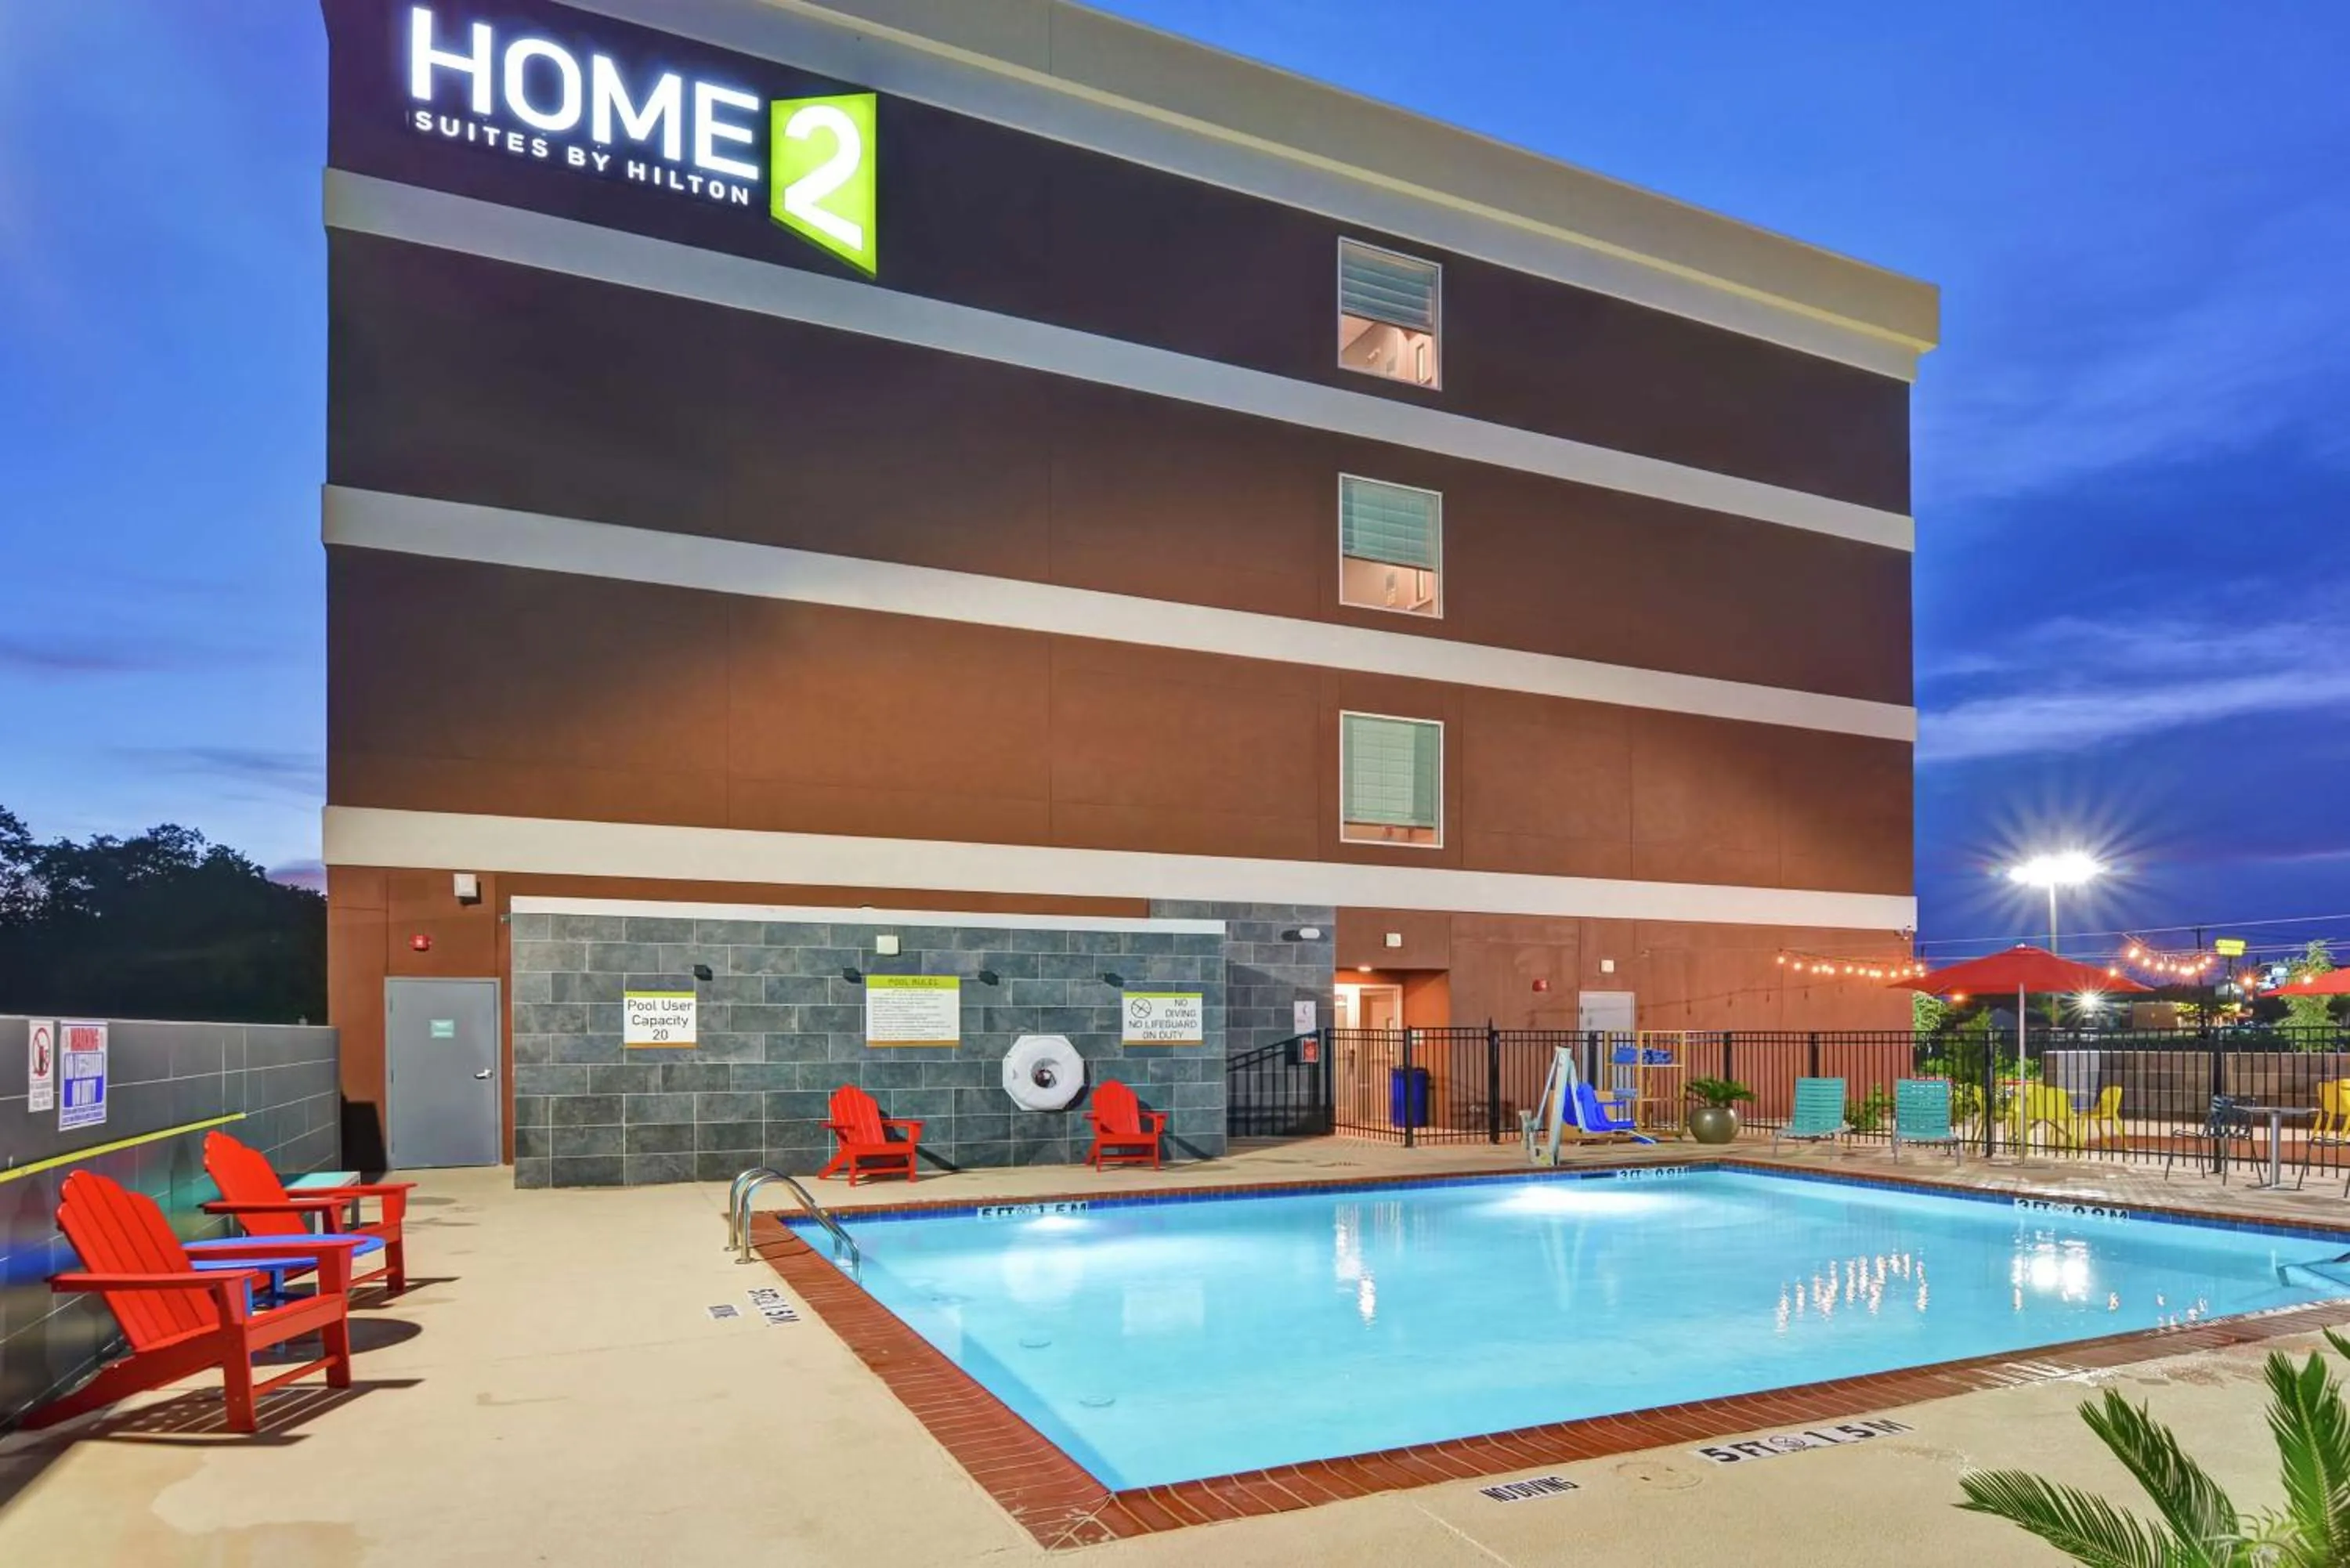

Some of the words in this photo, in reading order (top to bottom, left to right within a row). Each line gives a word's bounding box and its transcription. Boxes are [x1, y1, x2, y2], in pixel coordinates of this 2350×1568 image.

[411, 6, 759, 180] HOME
[783, 105, 863, 251] 2
[414, 110, 548, 158] SUITES
[567, 146, 611, 172] BY
[627, 161, 750, 206] HILTON
[627, 999, 657, 1011] Pool
[661, 999, 693, 1011] User
[1173, 999, 1188, 1007] NO
[1165, 1009, 1196, 1017] DIVING
[632, 1014, 689, 1028] Capacity
[1128, 1020, 1143, 1028] NO
[1144, 1020, 1197, 1028] LIFEGUARD
[652, 1028, 668, 1041] 20
[1142, 1031, 1157, 1039] ON
[1159, 1031, 1184, 1039] DUTY
[1479, 1487, 1519, 1502] NO
[1504, 1476, 1579, 1498] DIVING
